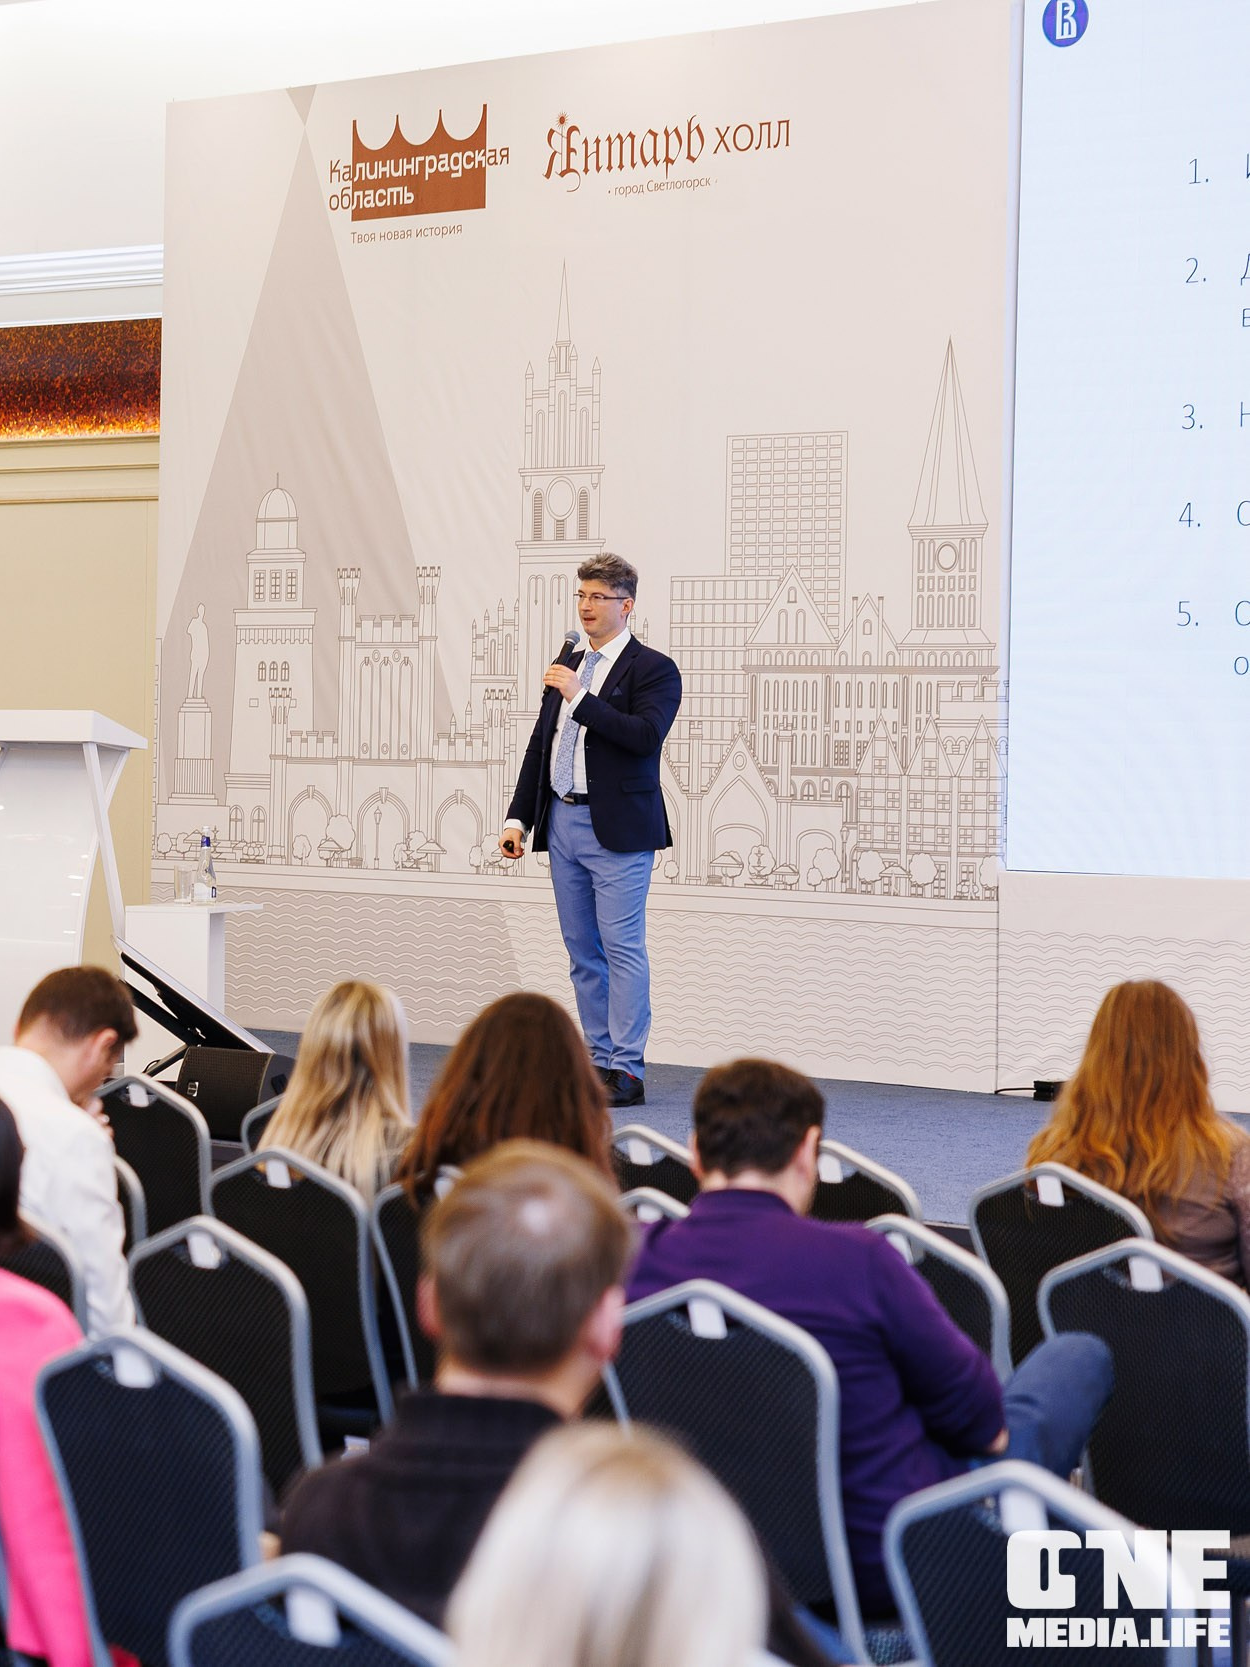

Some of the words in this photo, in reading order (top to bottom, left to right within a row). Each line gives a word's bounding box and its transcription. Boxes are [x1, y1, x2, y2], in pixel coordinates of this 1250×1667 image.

[329, 147, 510, 183] Калининградская
[1189, 158, 1209, 184] 1.
[329, 186, 415, 211] область
[614, 184, 645, 198] город
[646, 177, 711, 193] Светлогорск
[350, 231, 376, 244] Твоя
[379, 229, 412, 242] новая
[415, 224, 463, 239] история
[1185, 257, 1206, 283] 2.
[1181, 403, 1203, 429] 3.
[1178, 502, 1201, 527] 4.
[1176, 601, 1199, 627] 5.
